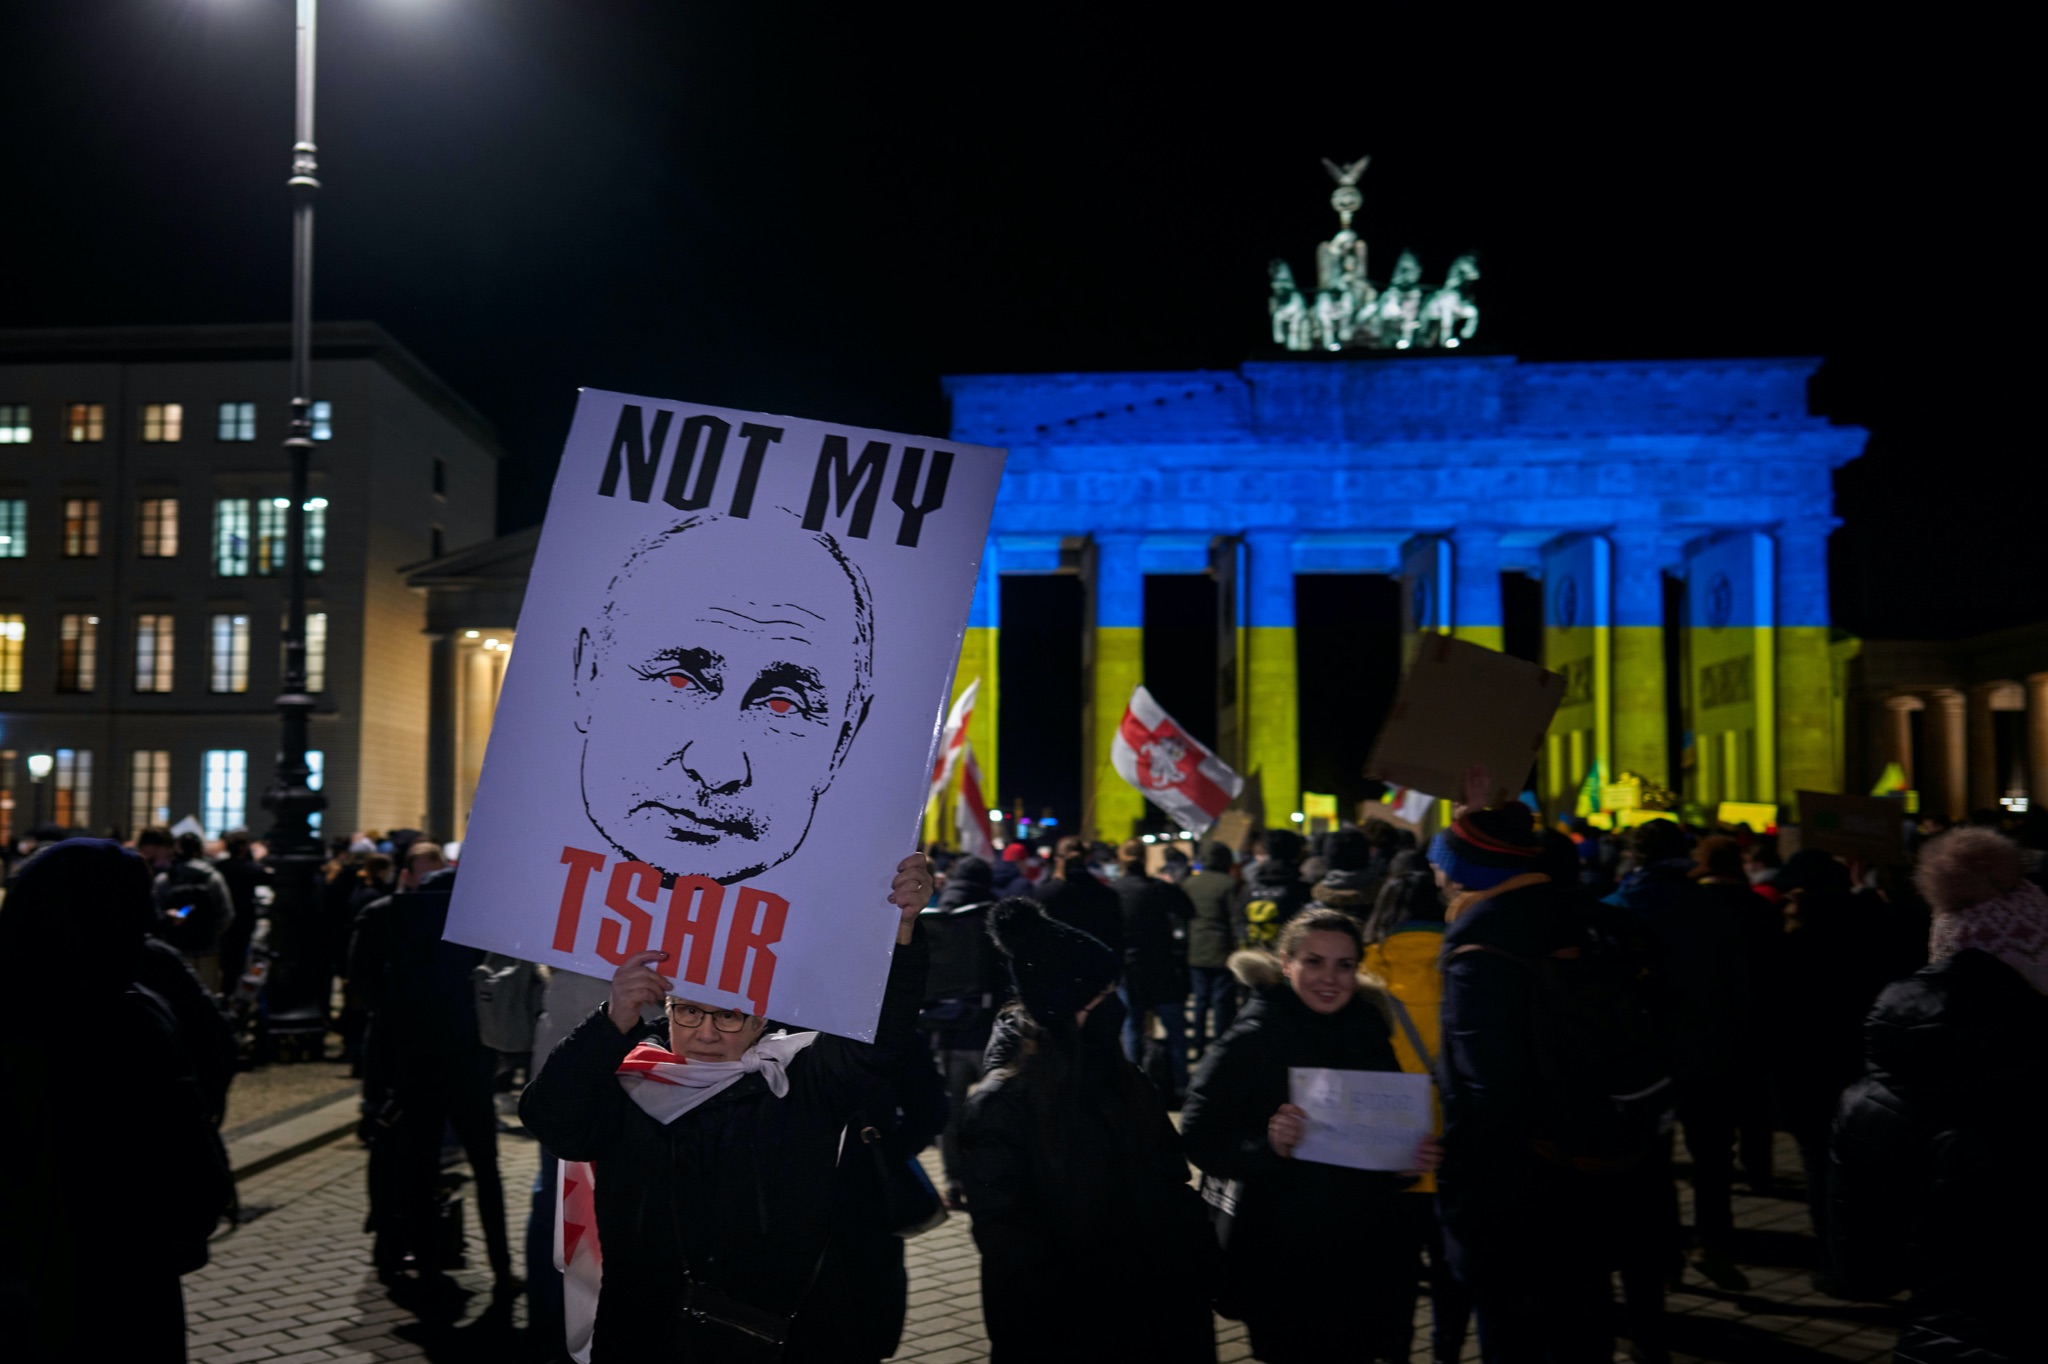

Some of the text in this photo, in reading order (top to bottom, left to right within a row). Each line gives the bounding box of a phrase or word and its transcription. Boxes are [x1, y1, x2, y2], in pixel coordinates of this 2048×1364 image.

[598, 404, 954, 548] NOT MY
[552, 846, 790, 1017] TSAR
